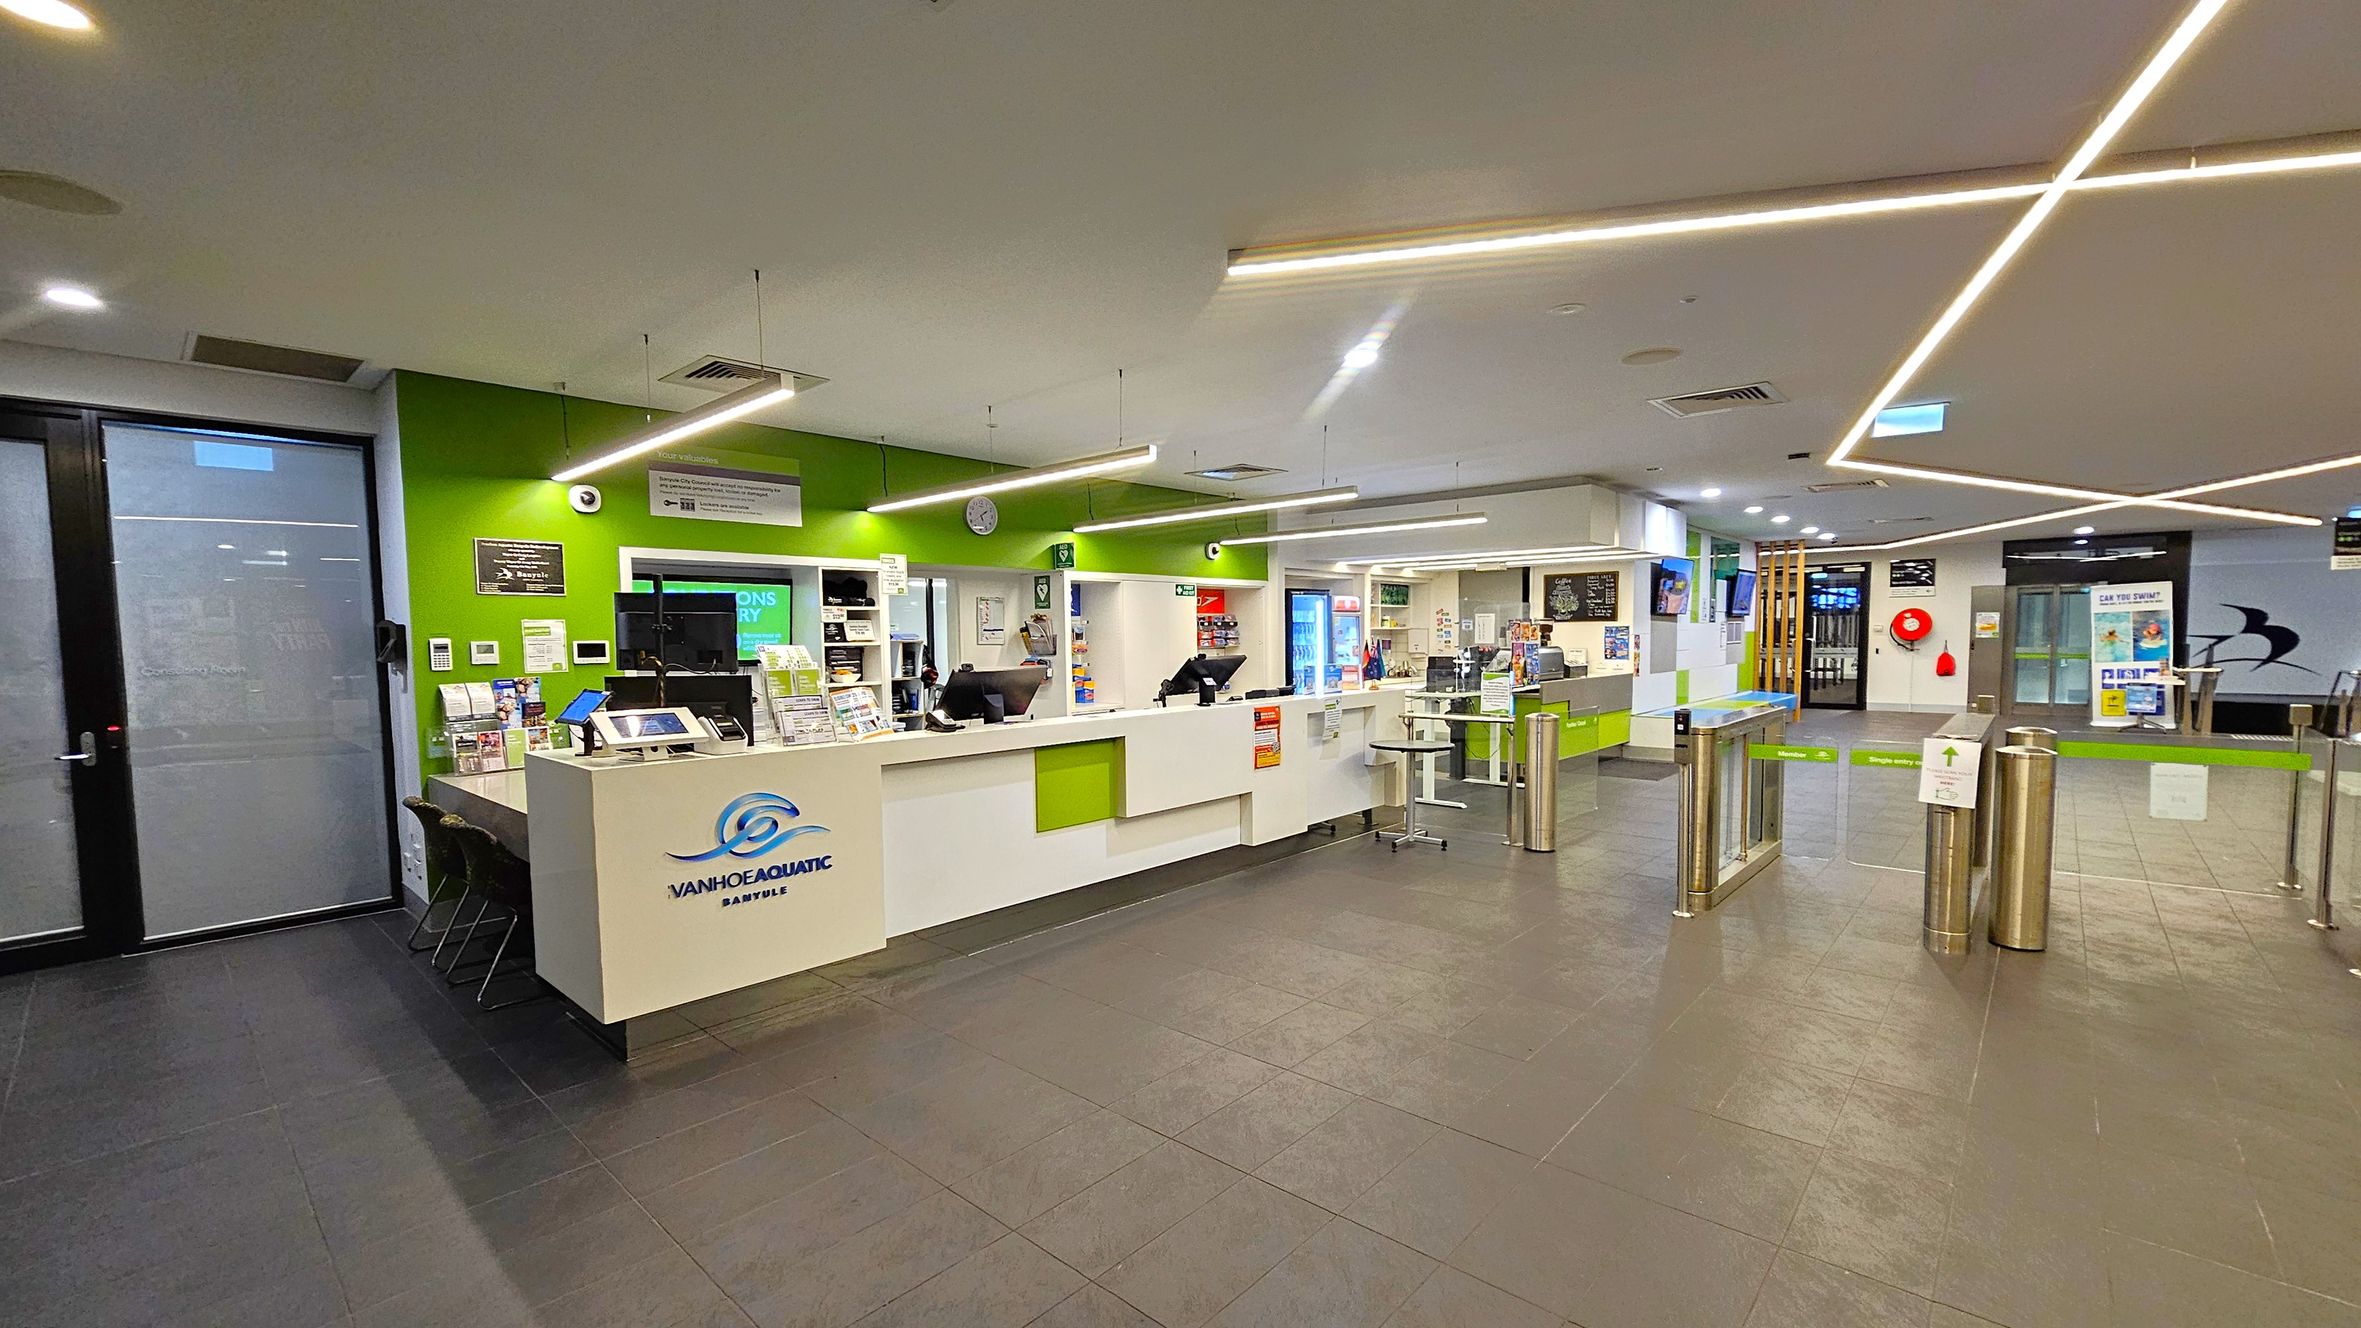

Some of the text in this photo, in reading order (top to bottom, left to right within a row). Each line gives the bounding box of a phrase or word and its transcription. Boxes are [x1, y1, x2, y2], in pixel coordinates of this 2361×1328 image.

[679, 453, 719, 464] valuables
[516, 571, 549, 579] Banyule
[2116, 593, 2131, 601] YOU
[2133, 592, 2161, 600] SWIM?
[1778, 750, 1807, 758] Member
[1869, 756, 1893, 764] Single
[722, 886, 788, 907] BANYULE
